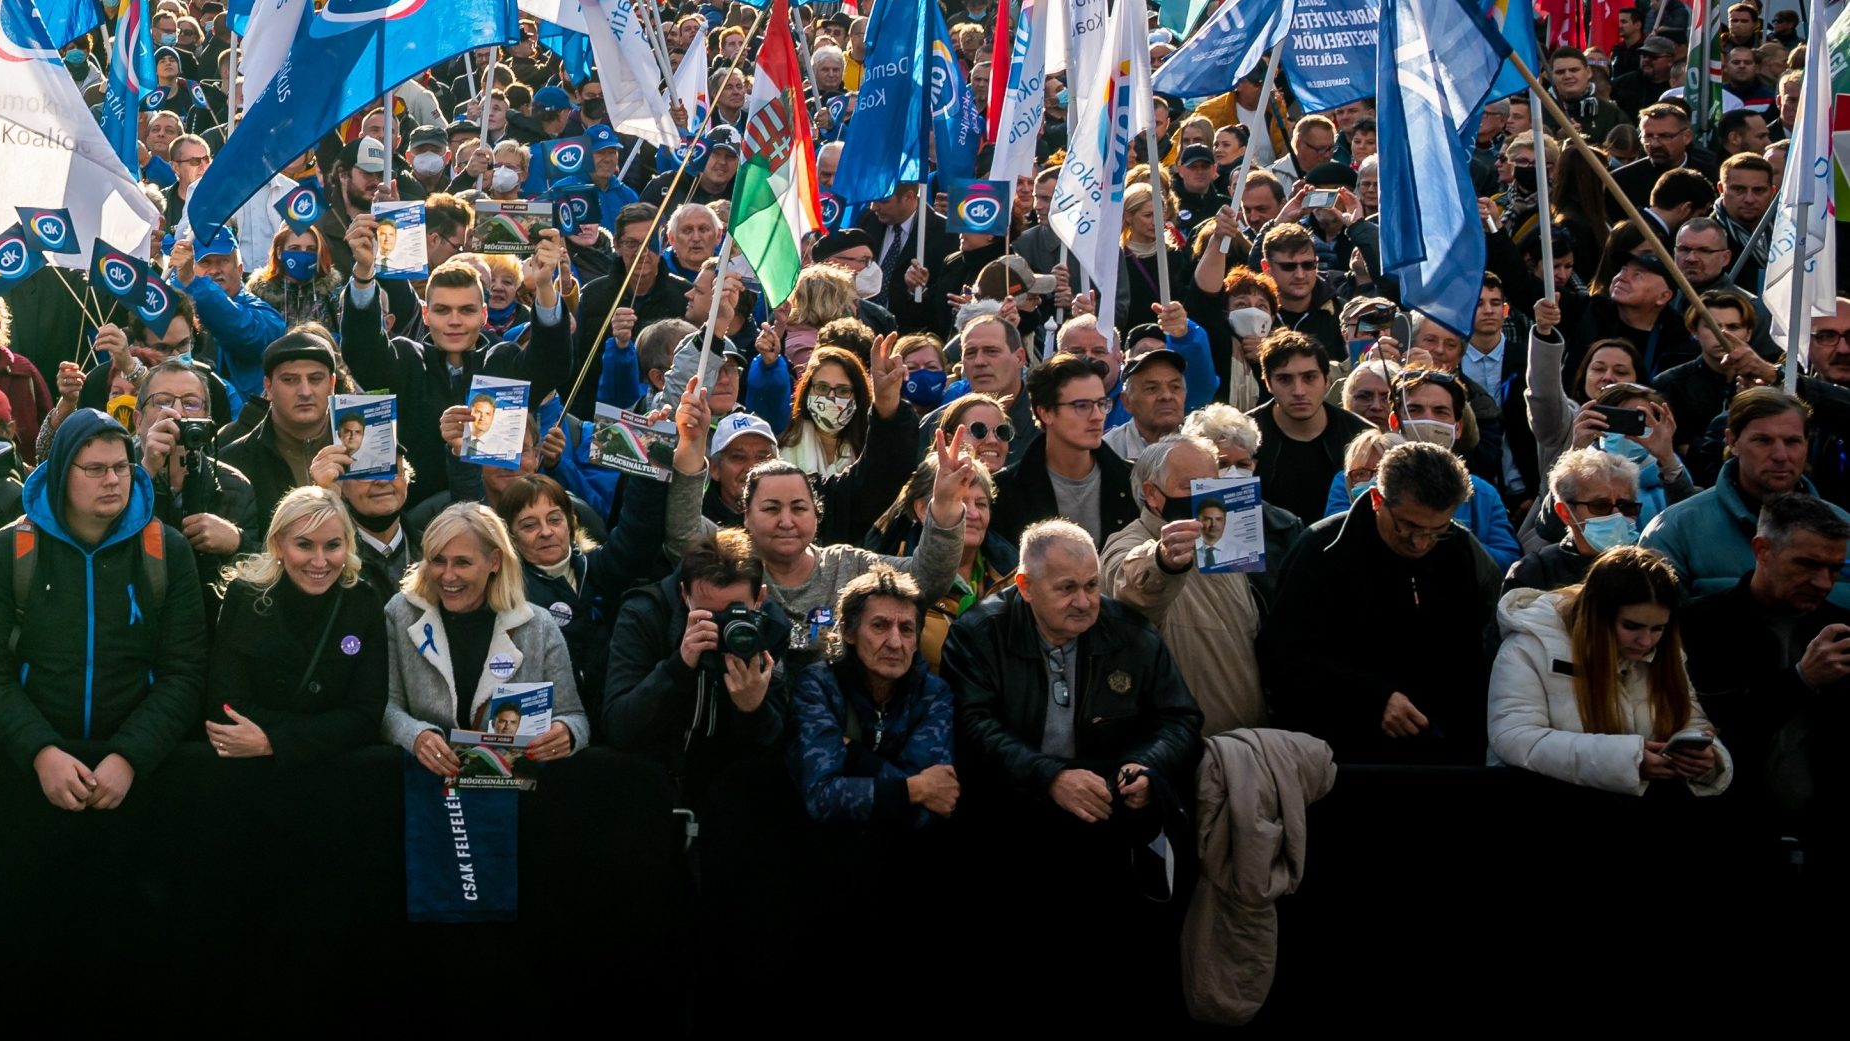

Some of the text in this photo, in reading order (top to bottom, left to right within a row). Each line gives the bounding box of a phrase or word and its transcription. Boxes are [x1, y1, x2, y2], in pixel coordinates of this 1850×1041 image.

[560, 149, 577, 162] dk
[970, 204, 989, 218] dk
[43, 221, 60, 236] dk
[1, 249, 20, 268] dk
[110, 266, 127, 282] dk
[444, 796, 478, 901] CSAK FELFELÉ!
